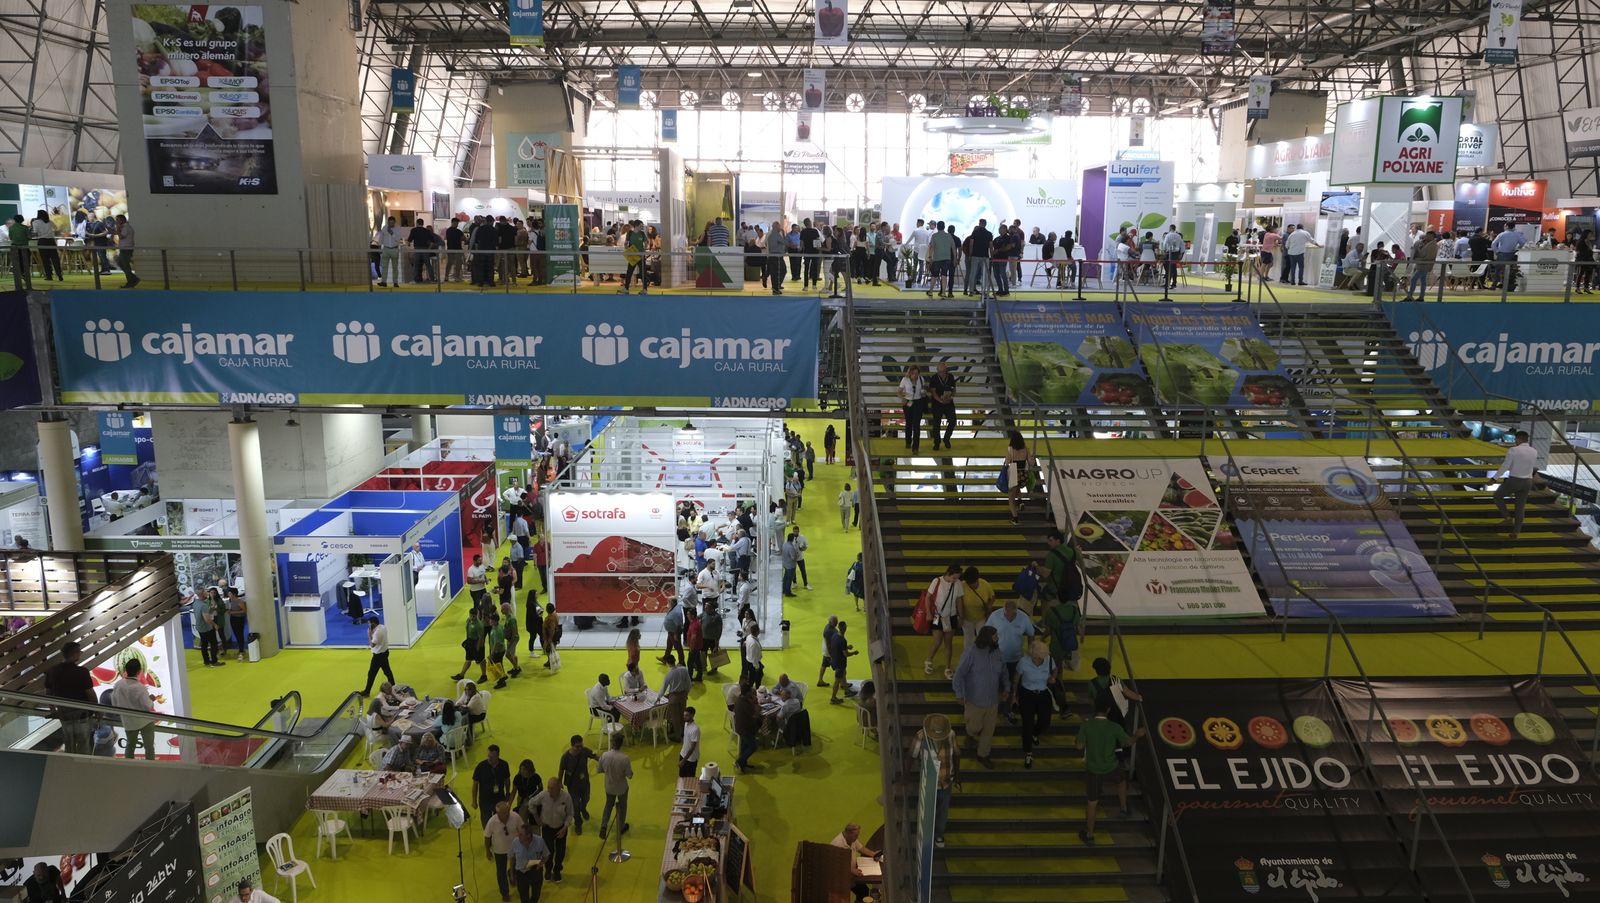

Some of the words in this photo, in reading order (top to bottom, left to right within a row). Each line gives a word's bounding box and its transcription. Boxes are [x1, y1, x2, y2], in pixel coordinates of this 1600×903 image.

[163, 38, 182, 47] K+S
[209, 40, 237, 49] grupo
[167, 51, 200, 60] minero
[201, 51, 235, 60] alemán
[1398, 147, 1431, 159] AGRI
[1111, 164, 1160, 176] Liquifert
[1382, 160, 1444, 173] POLYANE
[239, 177, 260, 186] K+S
[1501, 186, 1536, 197] Kultiva
[142, 323, 294, 364] cajamar
[391, 325, 543, 366] cajamar
[640, 327, 791, 368] cajamar
[1458, 333, 1600, 372] cajamar
[219, 357, 249, 367] CAJA
[253, 357, 293, 368] RURAL
[467, 360, 497, 369] CAJA
[501, 360, 541, 369] RURAL
[714, 362, 744, 372] CAJA
[749, 362, 788, 372] RURAL
[1526, 366, 1556, 375] CAJA
[1558, 366, 1594, 375] RURAL
[230, 392, 295, 404] ADNAGRO
[476, 394, 542, 406] ADNAGRO
[722, 397, 787, 408] ADNAGRO
[498, 434, 527, 442] cajamar
[1240, 465, 1300, 476] Cepacet
[581, 507, 626, 519] sotrafa
[1270, 533, 1330, 544] Persicop
[1166, 758, 1221, 790] EL
[1227, 756, 1350, 790] EJIDO
[1396, 755, 1455, 786] EL
[1455, 754, 1580, 786] EJIDO
[1168, 790, 1311, 826] gourmet
[1285, 797, 1360, 809] QUALITY
[1408, 786, 1544, 822] gourmet
[1519, 793, 1593, 808] QUALITY
[216, 808, 252, 832] infoAgro
[218, 828, 254, 852] infoAgro
[220, 848, 257, 873] infoAgro
[1260, 857, 1320, 867] Ayuntamiento
[1321, 857, 1333, 865] de
[1505, 852, 1565, 862] Ayuntamiento
[1565, 852, 1577, 861] de
[147, 858, 177, 896] 24htv
